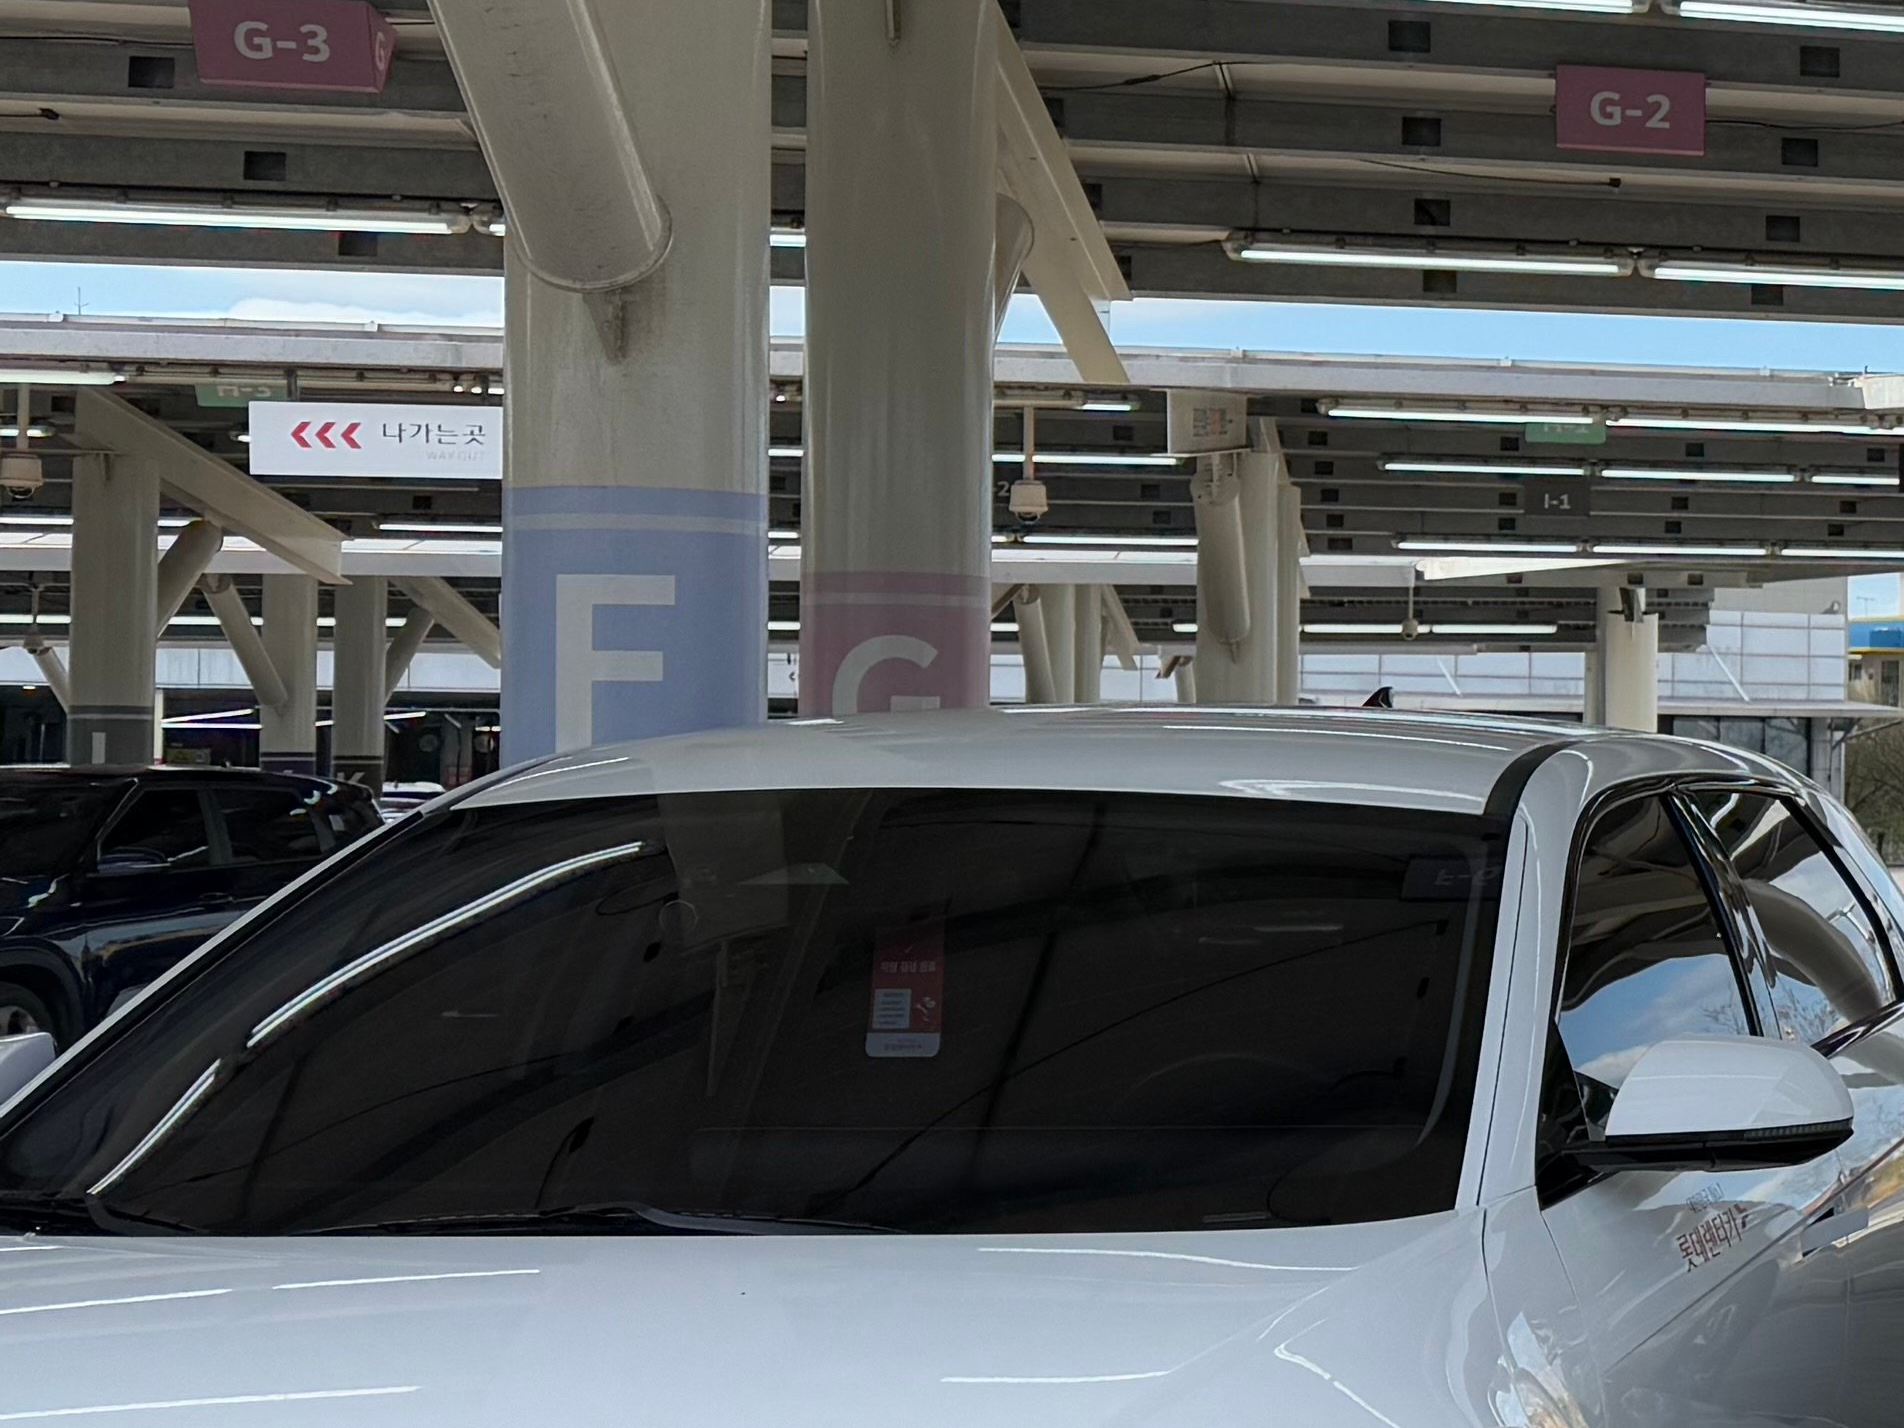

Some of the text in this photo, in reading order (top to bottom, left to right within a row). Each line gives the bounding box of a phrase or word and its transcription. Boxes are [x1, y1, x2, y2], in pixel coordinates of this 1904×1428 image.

[233, 20, 331, 63] G-3
[1590, 91, 1671, 129] G-2
[382, 422, 486, 445] 나가는곳
[426, 450, 455, 461] WAY
[1544, 493, 1571, 509] I-1
[555, 574, 676, 754] F
[1676, 1208, 1743, 1273] 롯데렌터카
